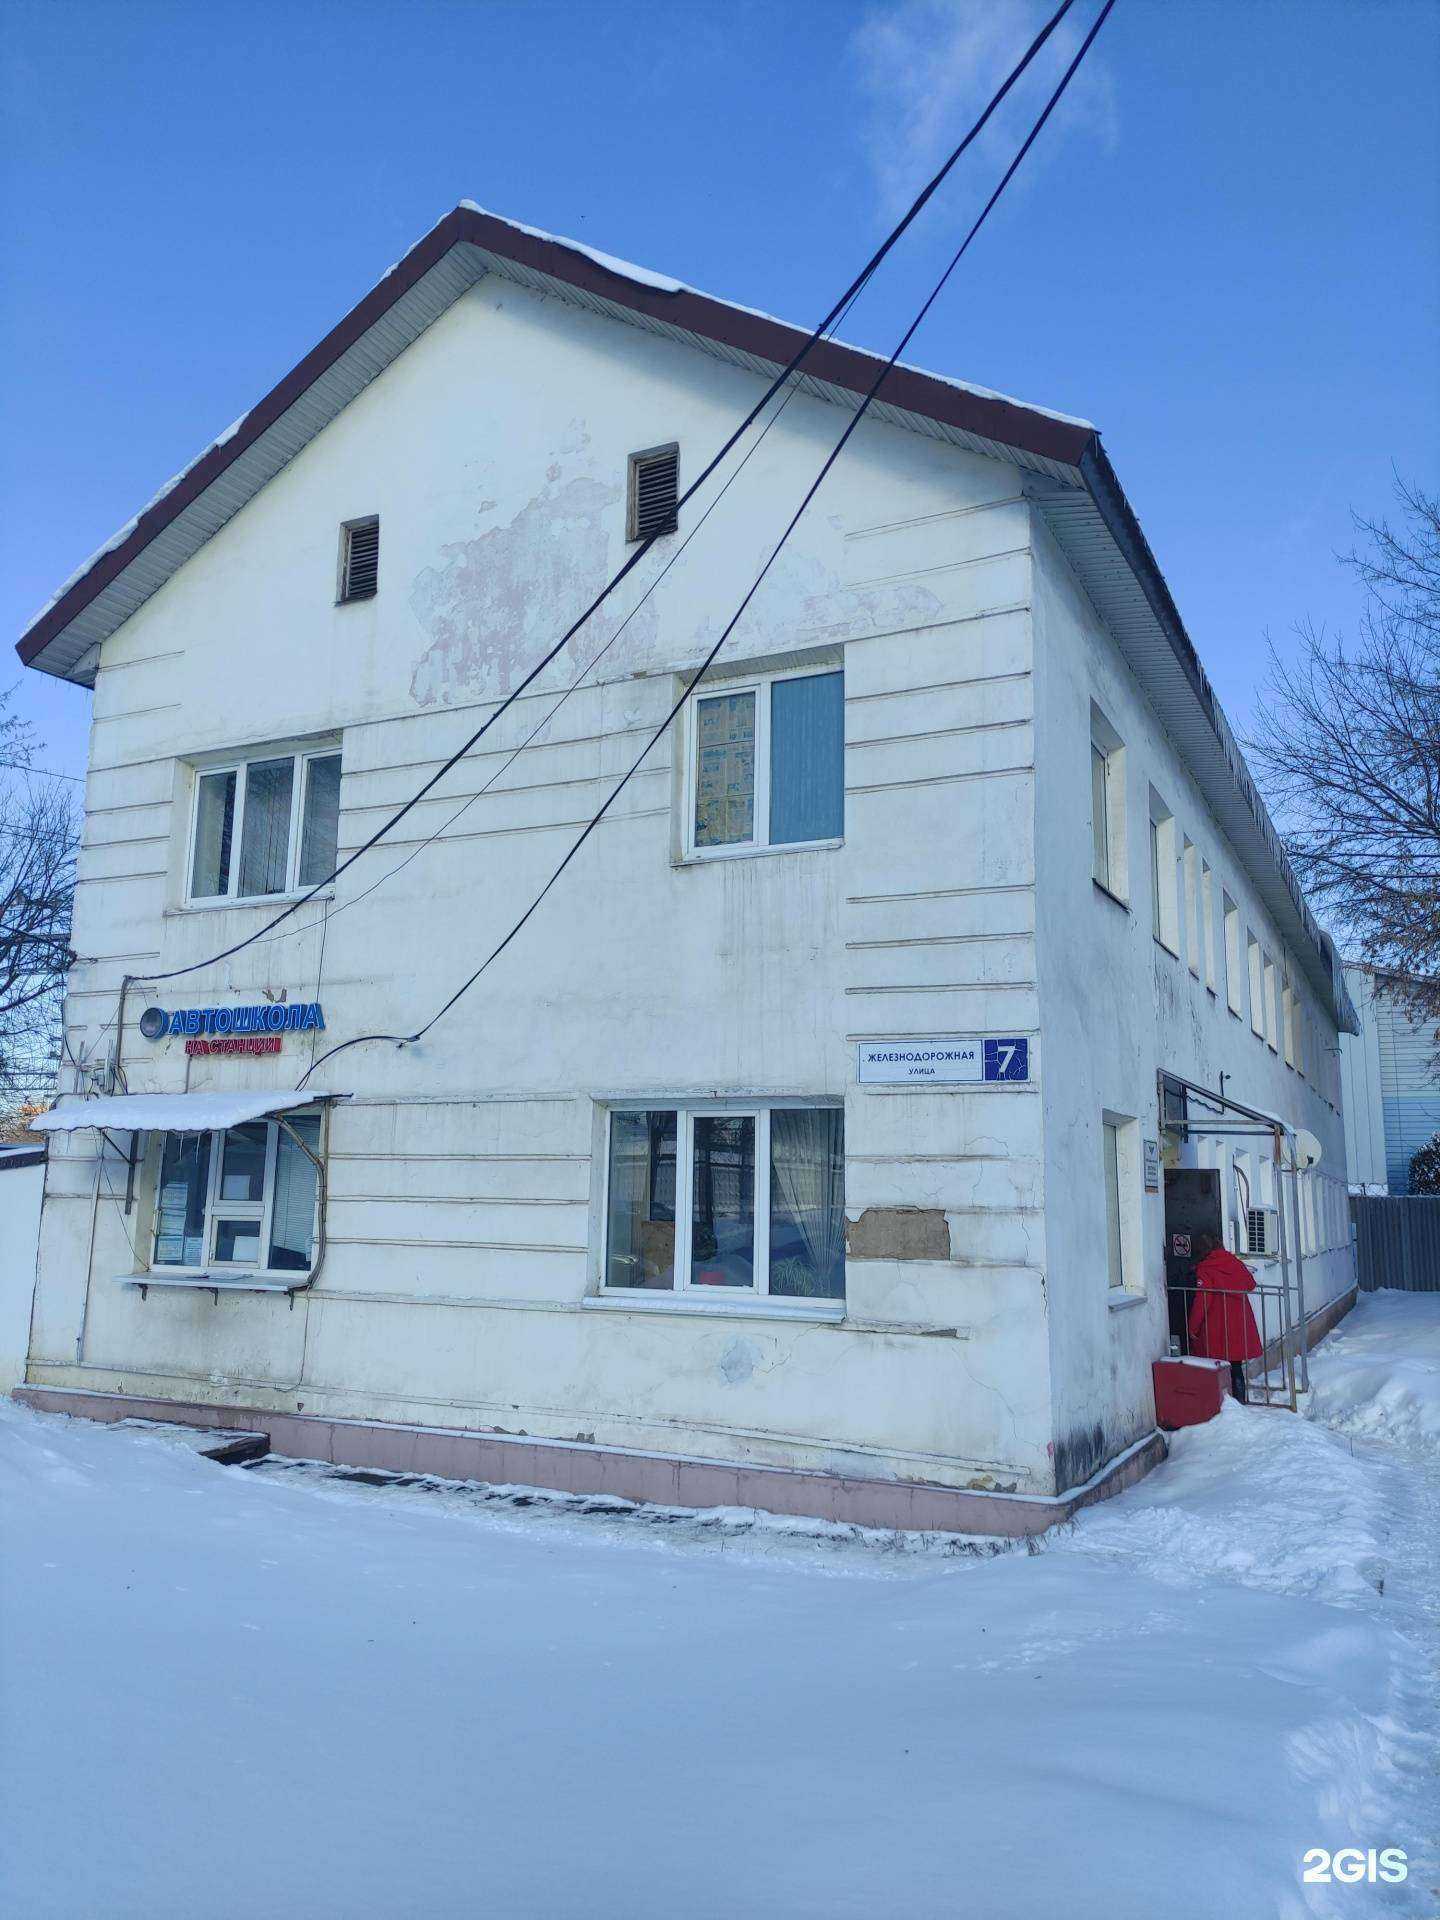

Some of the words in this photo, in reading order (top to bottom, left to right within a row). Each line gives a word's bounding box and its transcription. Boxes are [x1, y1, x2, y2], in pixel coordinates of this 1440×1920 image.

[168, 1003, 325, 1035] АВТОШКОЛА
[186, 1040, 206, 1056] НА
[209, 1037, 280, 1056] СТАНЦИИ
[868, 1051, 975, 1062] ЖЕЛЕЗНОДОРОЖНАЯ
[997, 1045, 1017, 1073] 7
[908, 1067, 936, 1076] УЛИЦА
